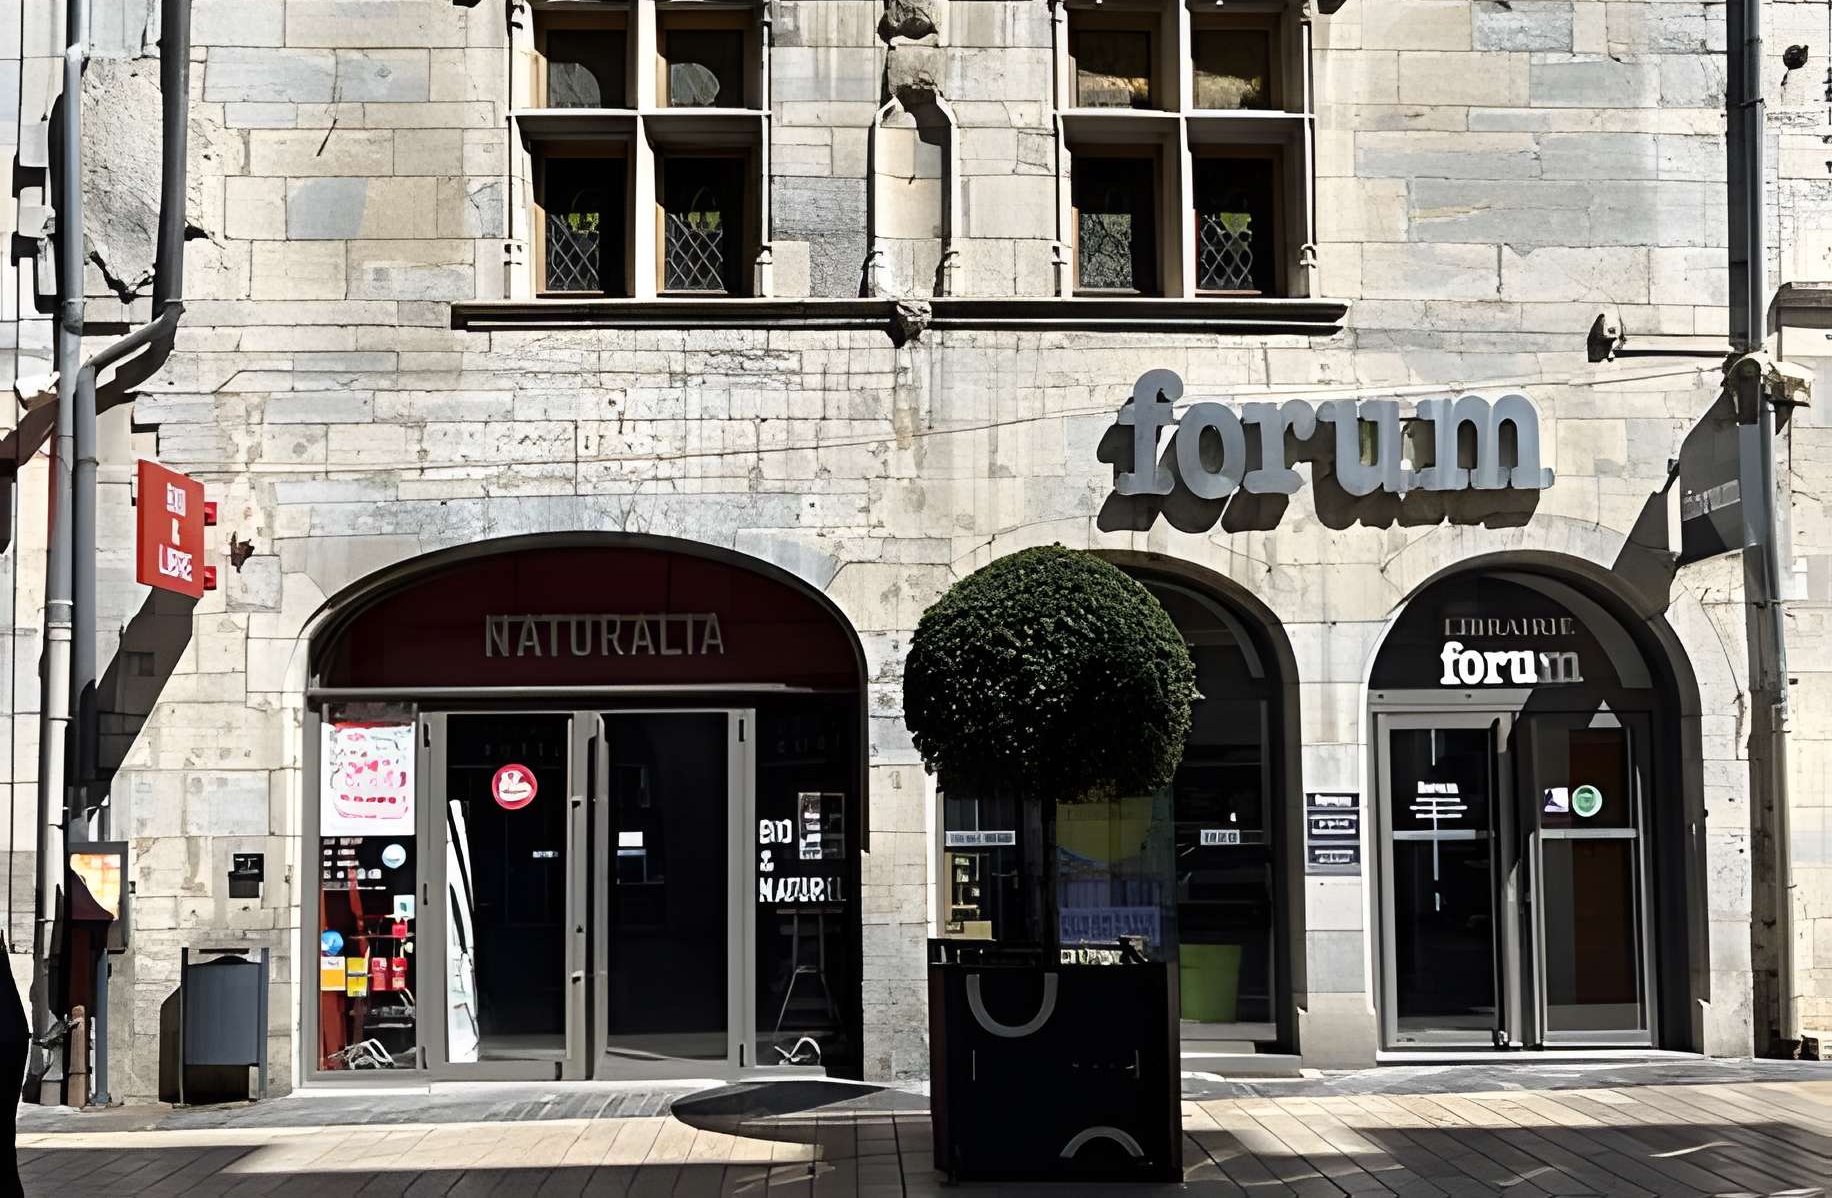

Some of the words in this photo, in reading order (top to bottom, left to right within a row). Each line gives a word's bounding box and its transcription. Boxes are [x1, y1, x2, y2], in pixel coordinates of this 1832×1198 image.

[1113, 368, 1556, 500] forum
[485, 613, 724, 657] NATURALIA
[1440, 641, 1584, 685] forum
